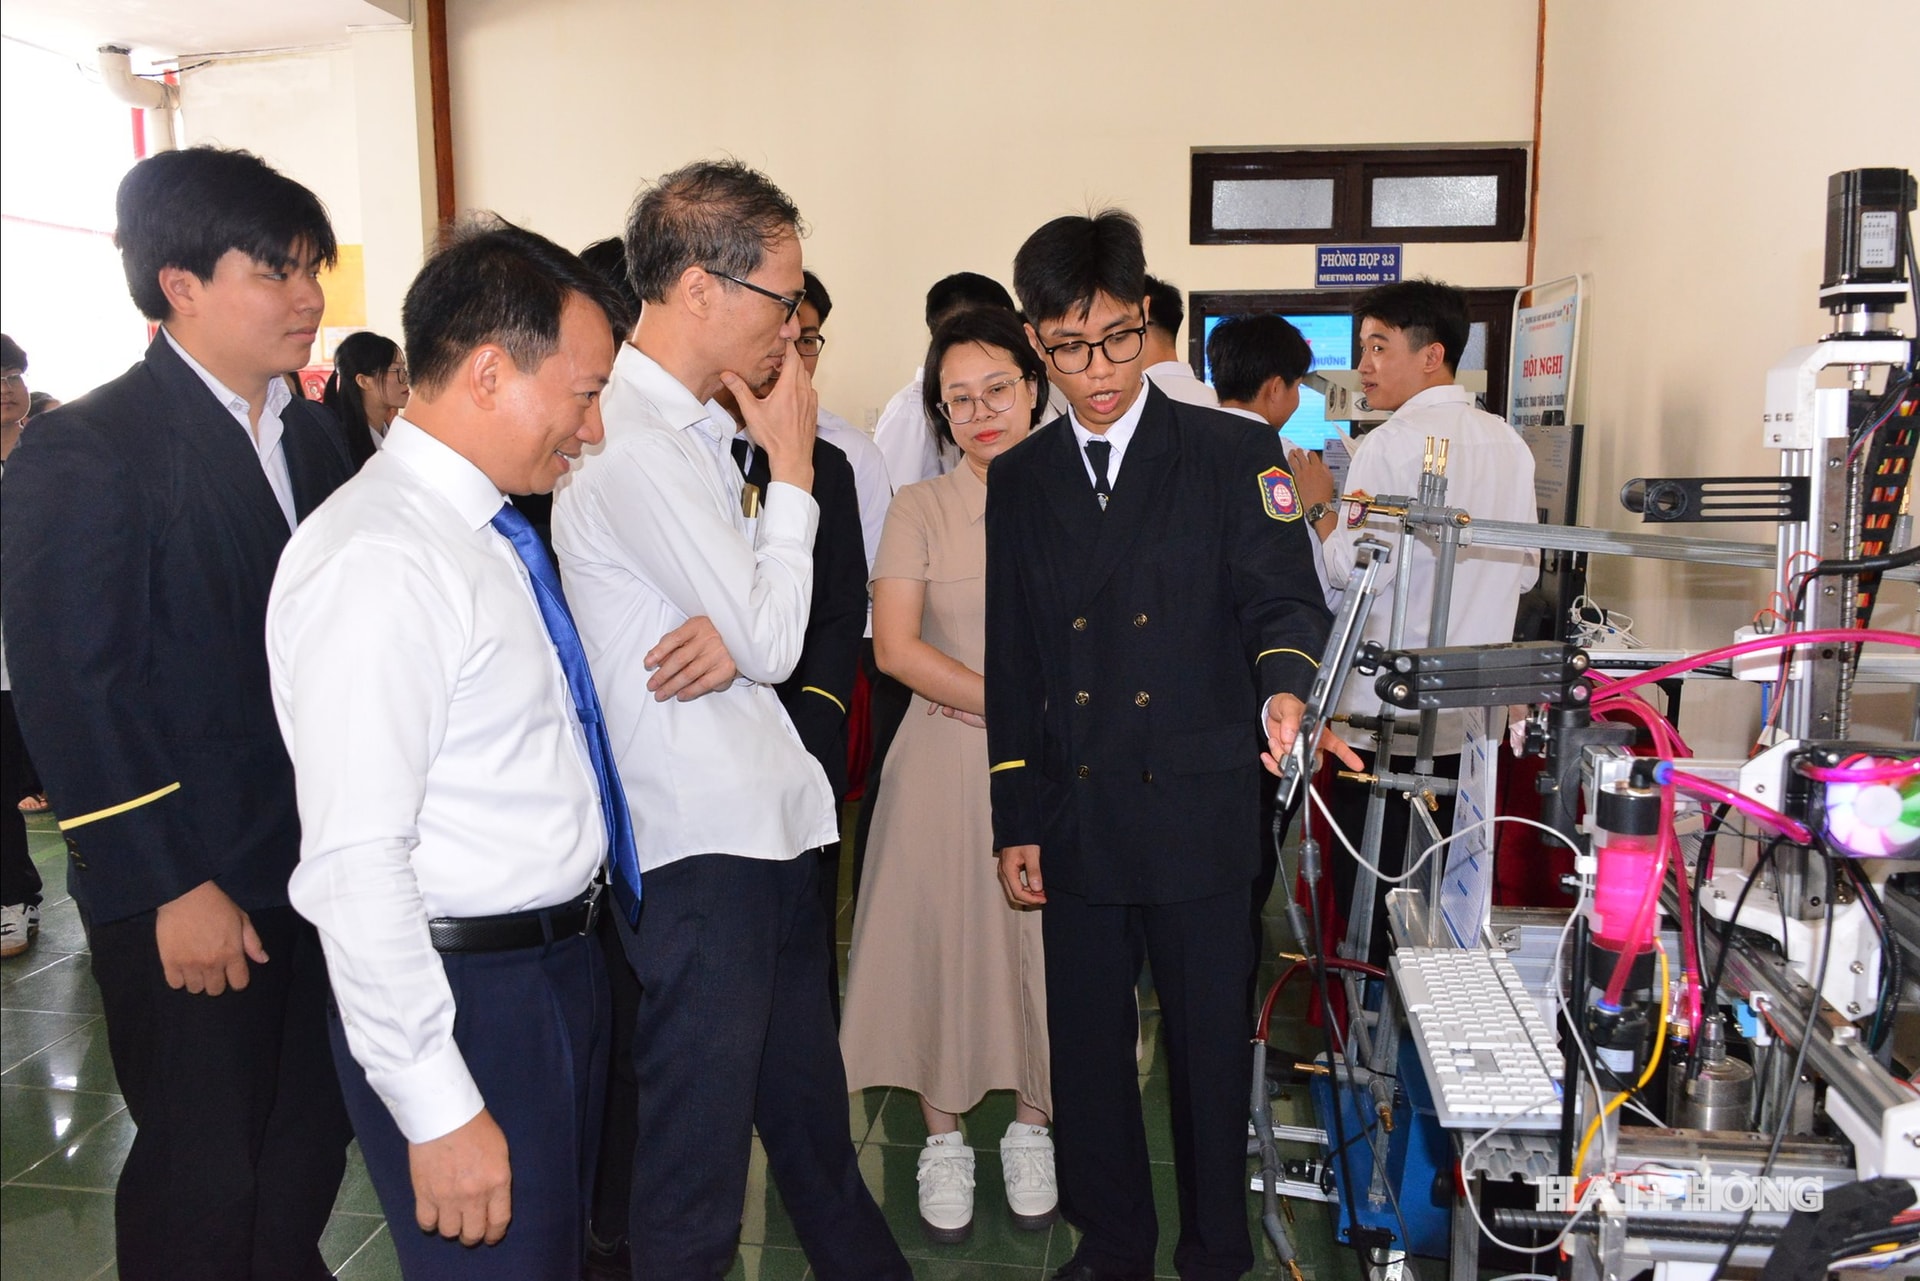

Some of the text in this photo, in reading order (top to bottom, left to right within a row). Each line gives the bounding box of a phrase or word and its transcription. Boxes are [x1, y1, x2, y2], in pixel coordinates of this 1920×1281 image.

[1321, 249, 1395, 270] PHÒNG HỌP 3.3
[1319, 273, 1396, 282] MEETING ROOM 3.3
[1522, 353, 1563, 382] HỘI NGHỊ
